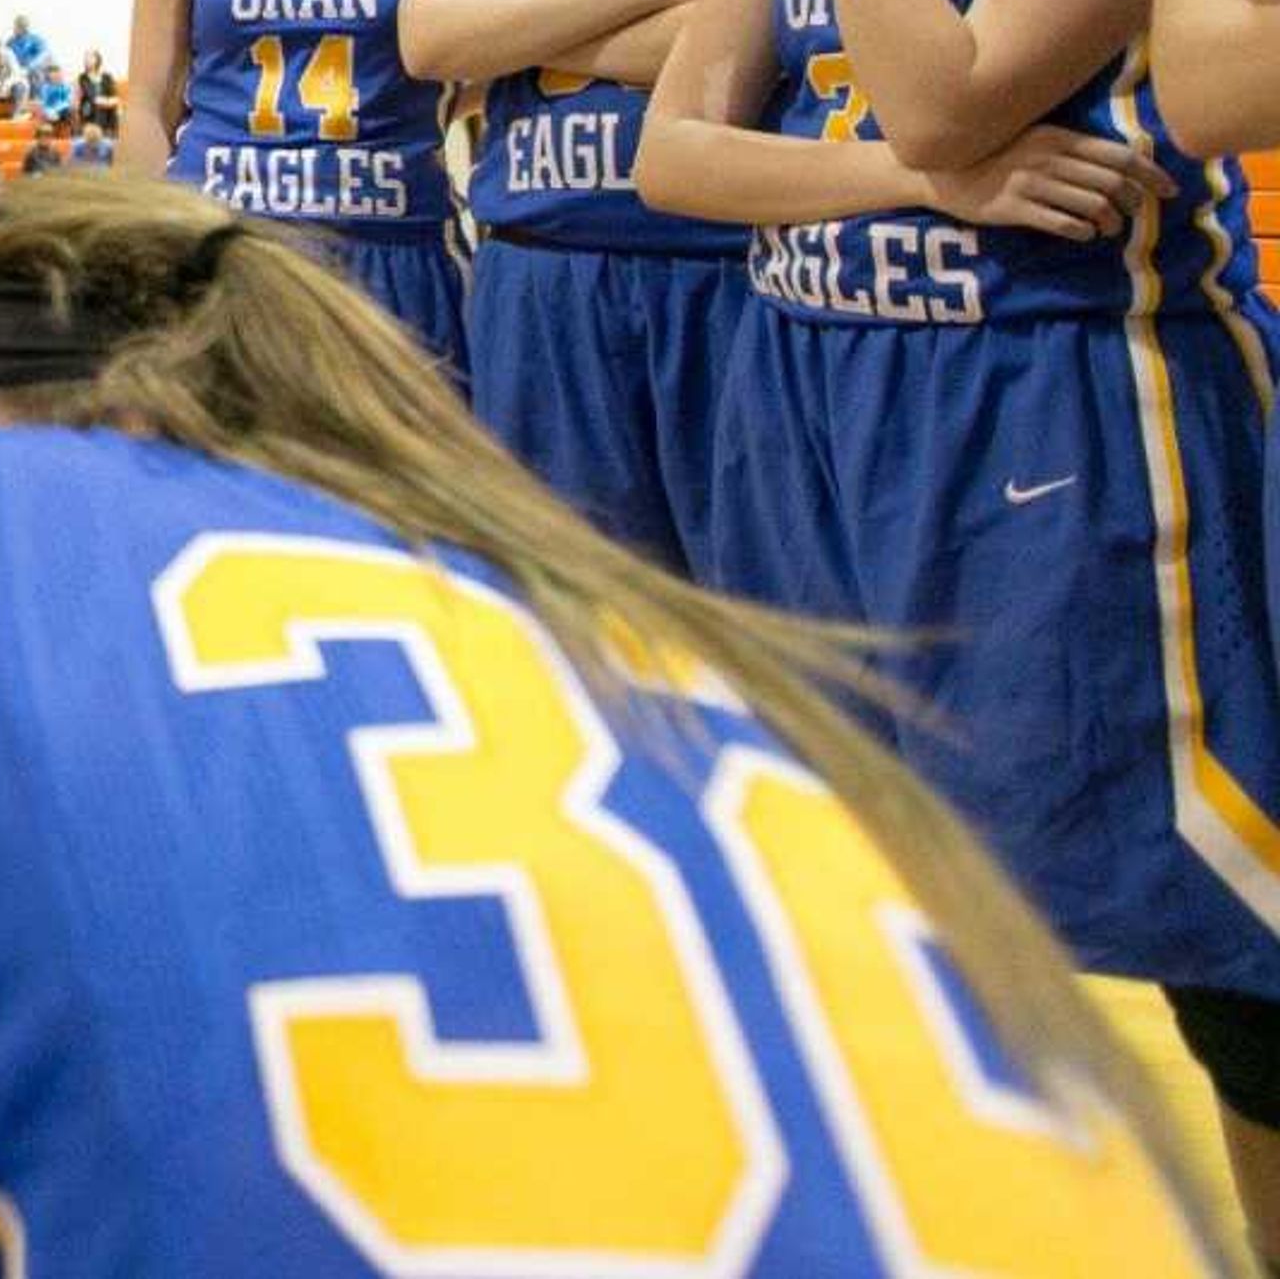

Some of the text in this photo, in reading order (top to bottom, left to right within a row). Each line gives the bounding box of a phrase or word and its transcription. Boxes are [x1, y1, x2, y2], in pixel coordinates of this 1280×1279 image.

[249, 34, 360, 142] 14
[201, 146, 407, 218] EAGLES
[506, 113, 637, 192] EAGL
